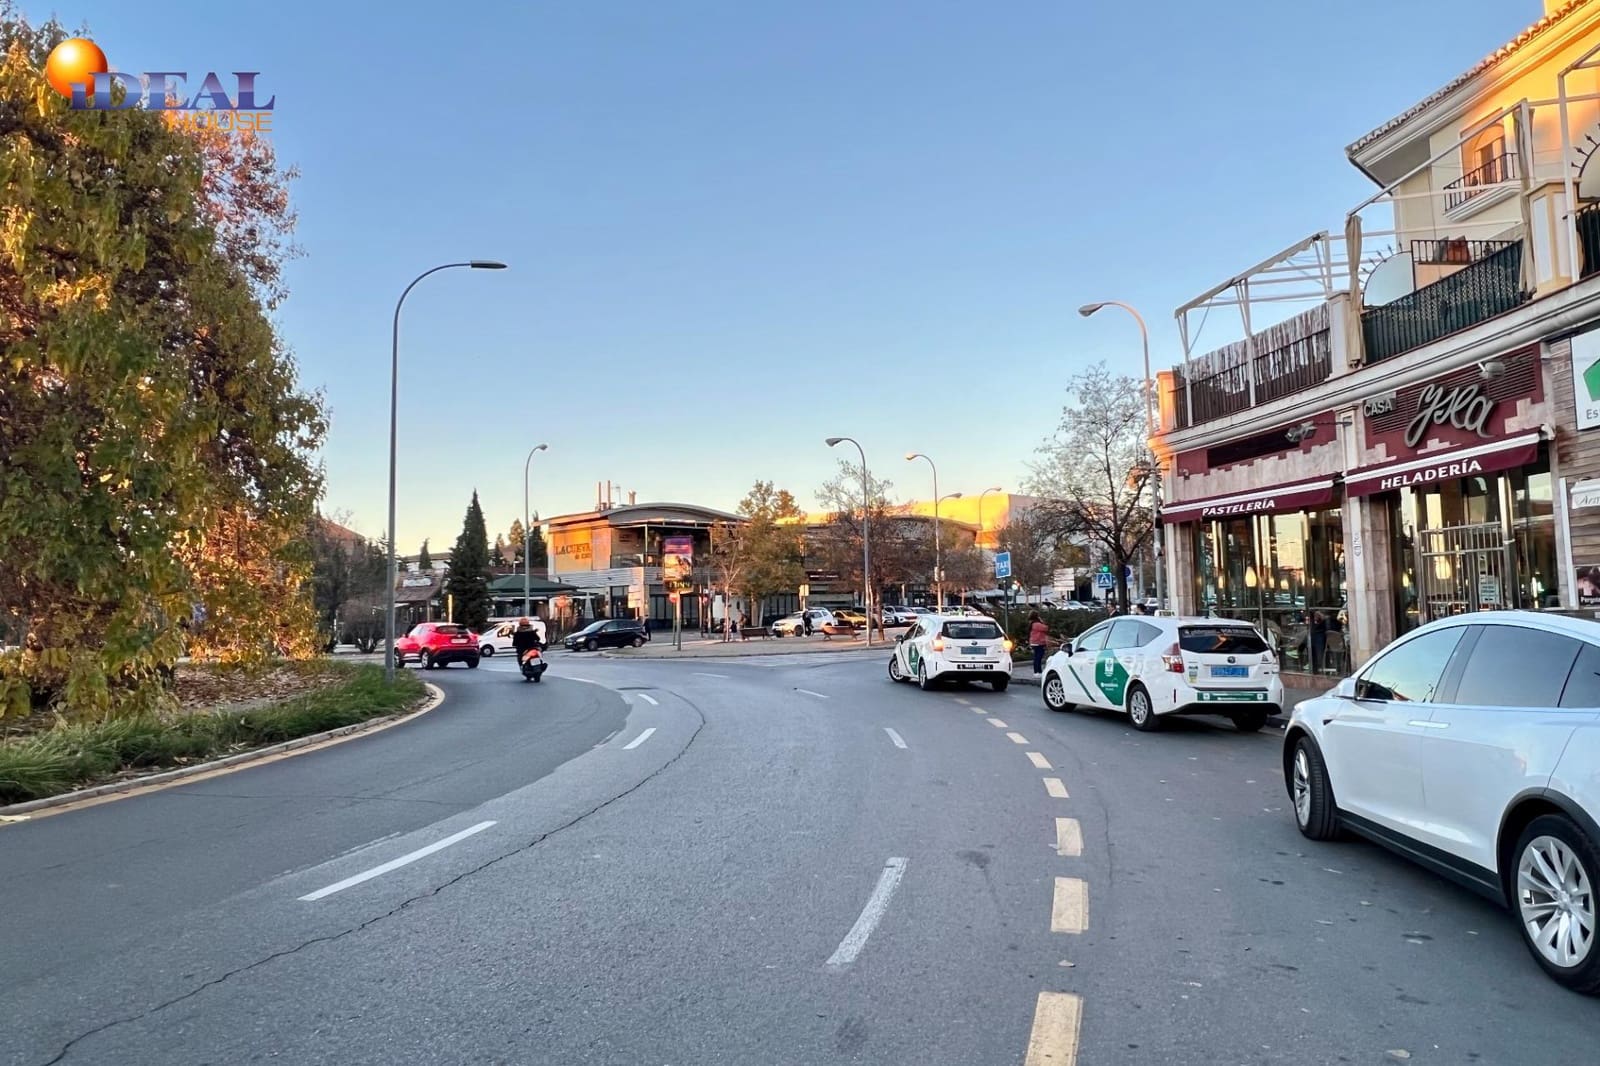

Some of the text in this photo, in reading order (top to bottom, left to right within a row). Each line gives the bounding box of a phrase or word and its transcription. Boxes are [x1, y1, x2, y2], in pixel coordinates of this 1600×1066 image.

[1363, 398, 1393, 417] CASA
[1586, 409, 1600, 420] Es
[1381, 459, 1482, 490] HELADERÍA
[1202, 499, 1275, 517] PASTELERÍA
